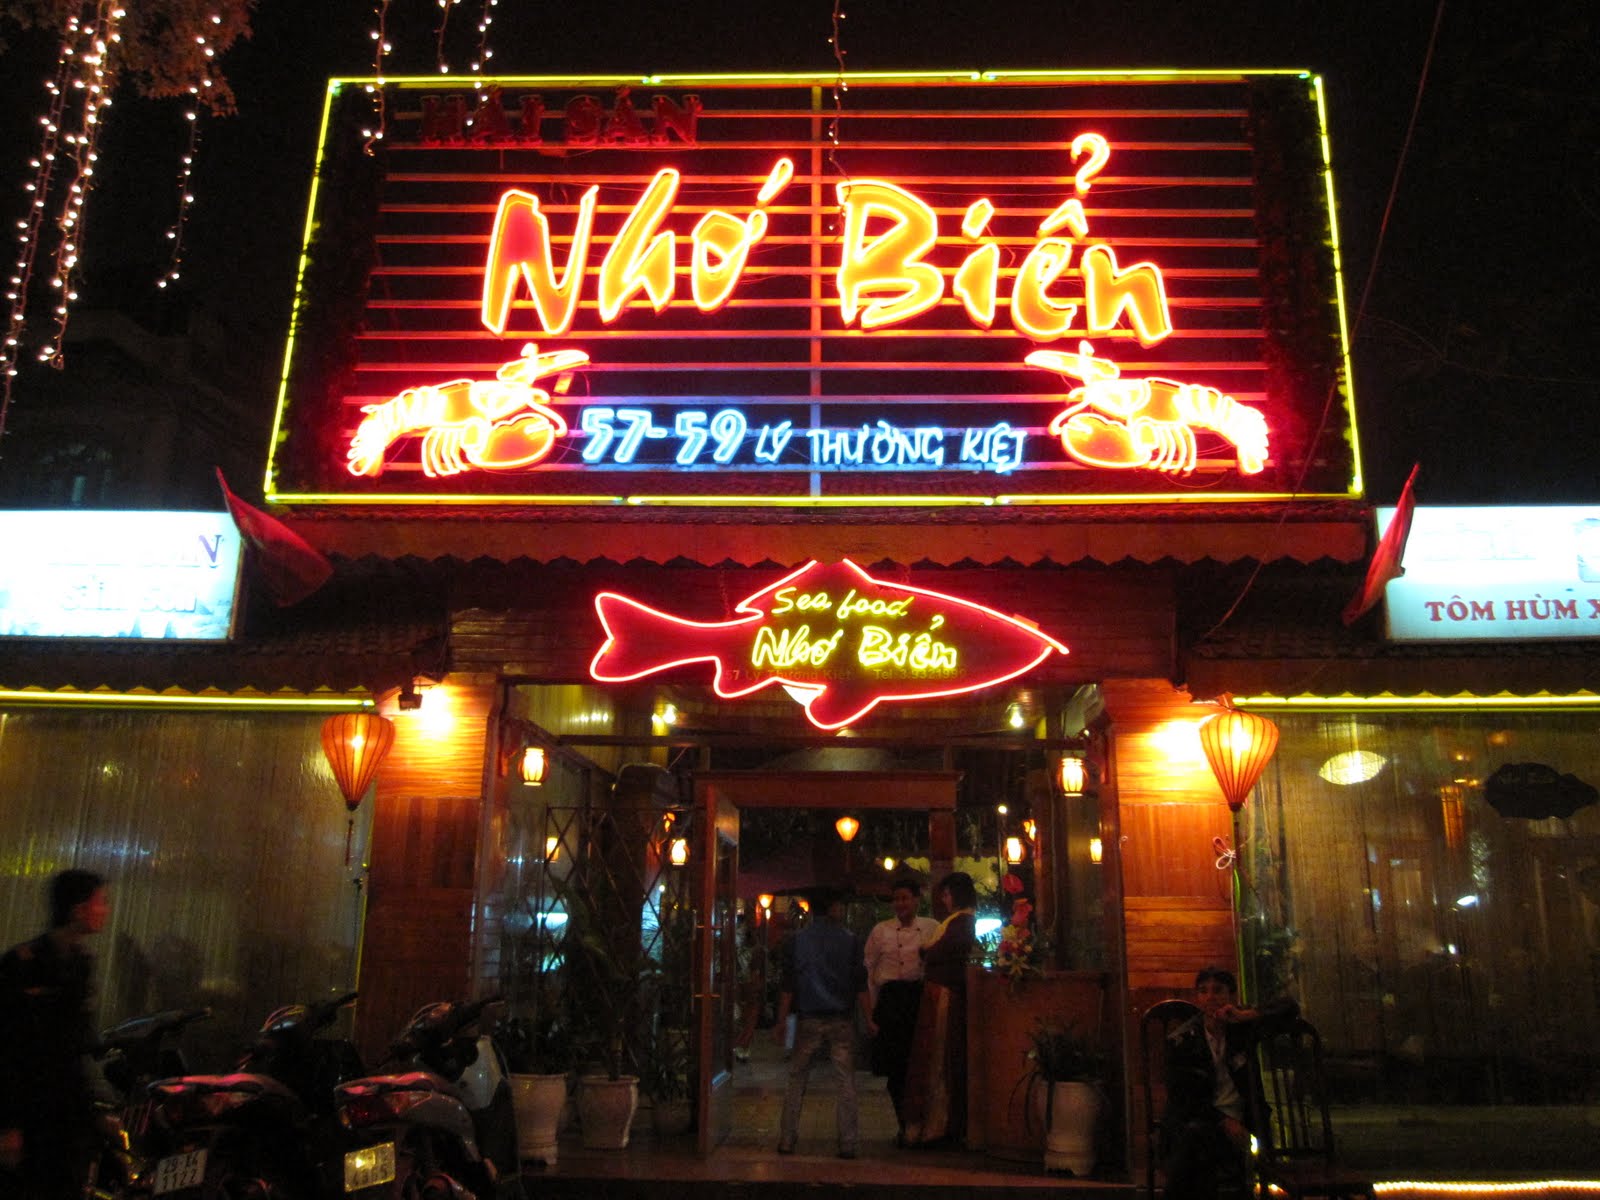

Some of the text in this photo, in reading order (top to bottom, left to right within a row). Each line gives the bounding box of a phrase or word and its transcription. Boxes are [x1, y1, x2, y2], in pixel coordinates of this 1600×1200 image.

[480, 131, 1176, 348] Nhớ Biển
[580, 406, 747, 464] 57-59
[805, 419, 945, 467] THƯỜNG
[771, 586, 915, 620] Sea food
[1424, 594, 1496, 622] TÔM
[1504, 593, 1579, 621] HÙM
[857, 614, 959, 670] Biển
